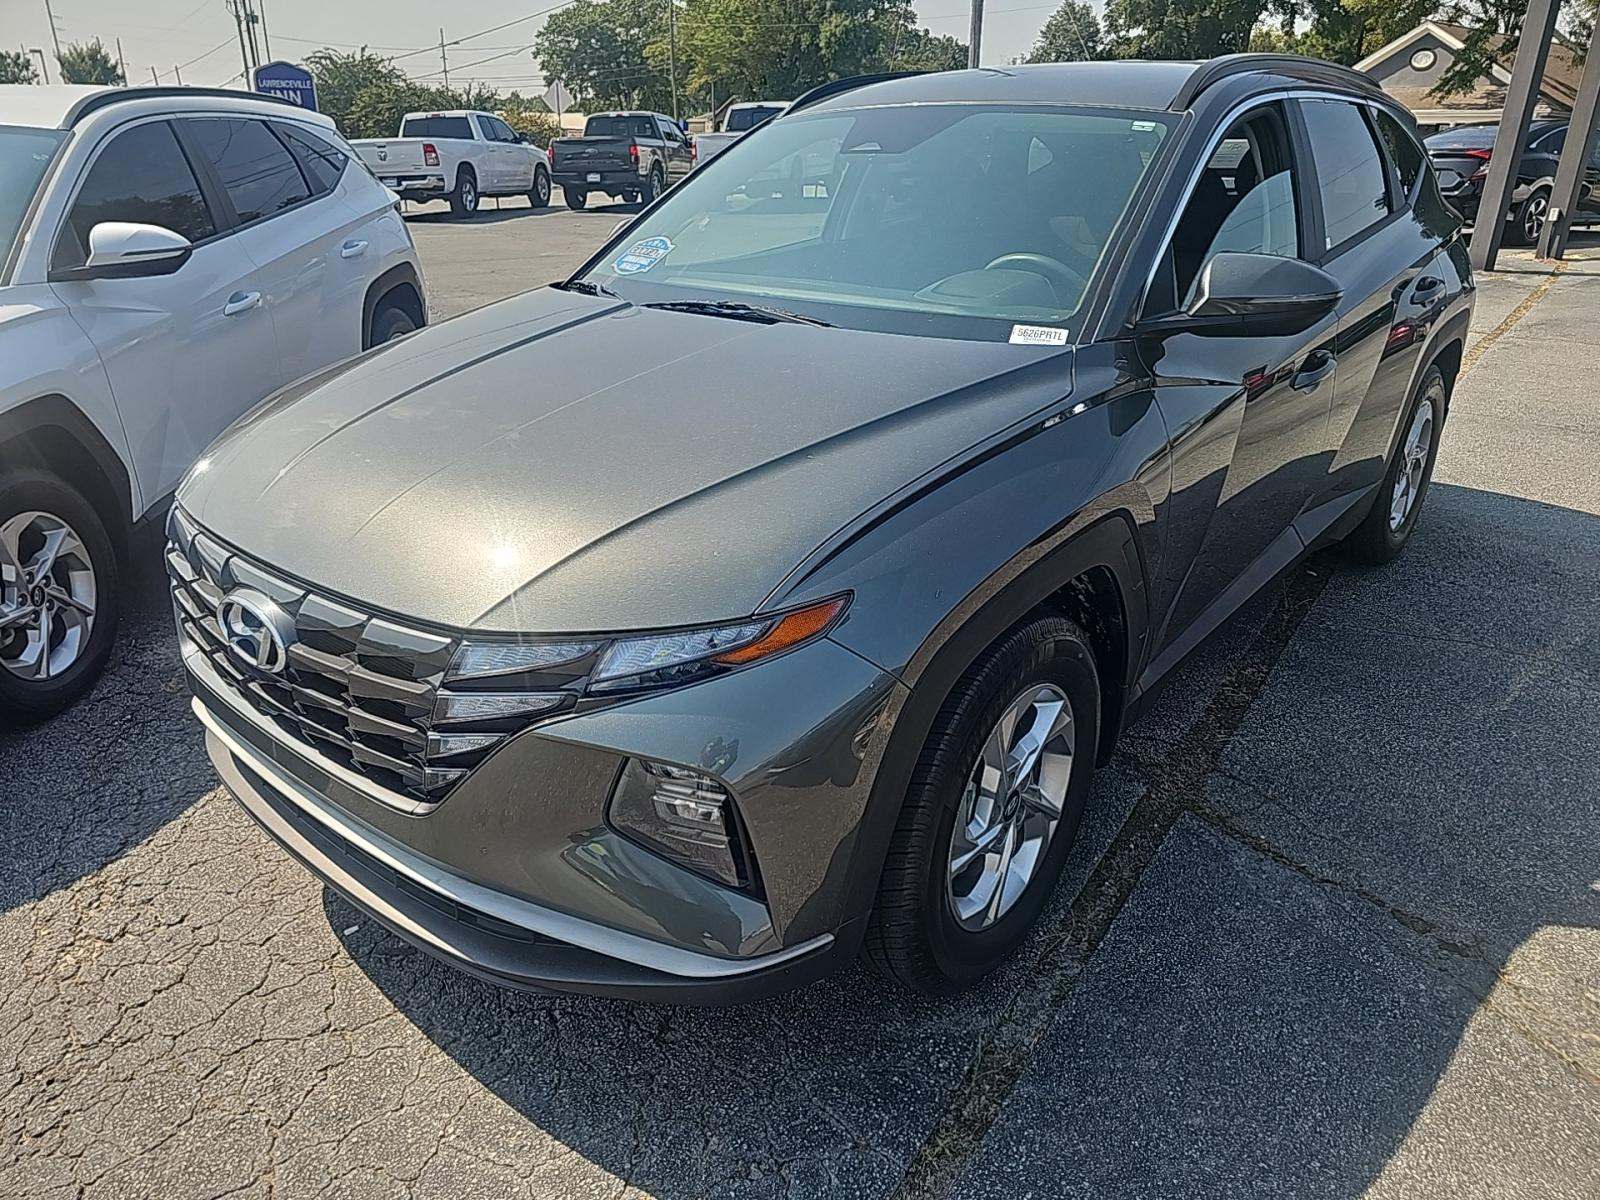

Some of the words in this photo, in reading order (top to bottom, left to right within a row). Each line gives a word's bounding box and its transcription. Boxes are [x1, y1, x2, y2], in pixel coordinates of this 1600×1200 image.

[258, 78, 312, 89] LAWRENCEVILLE
[270, 89, 302, 106] NN
[1017, 328, 1064, 341] 5626PRTL
